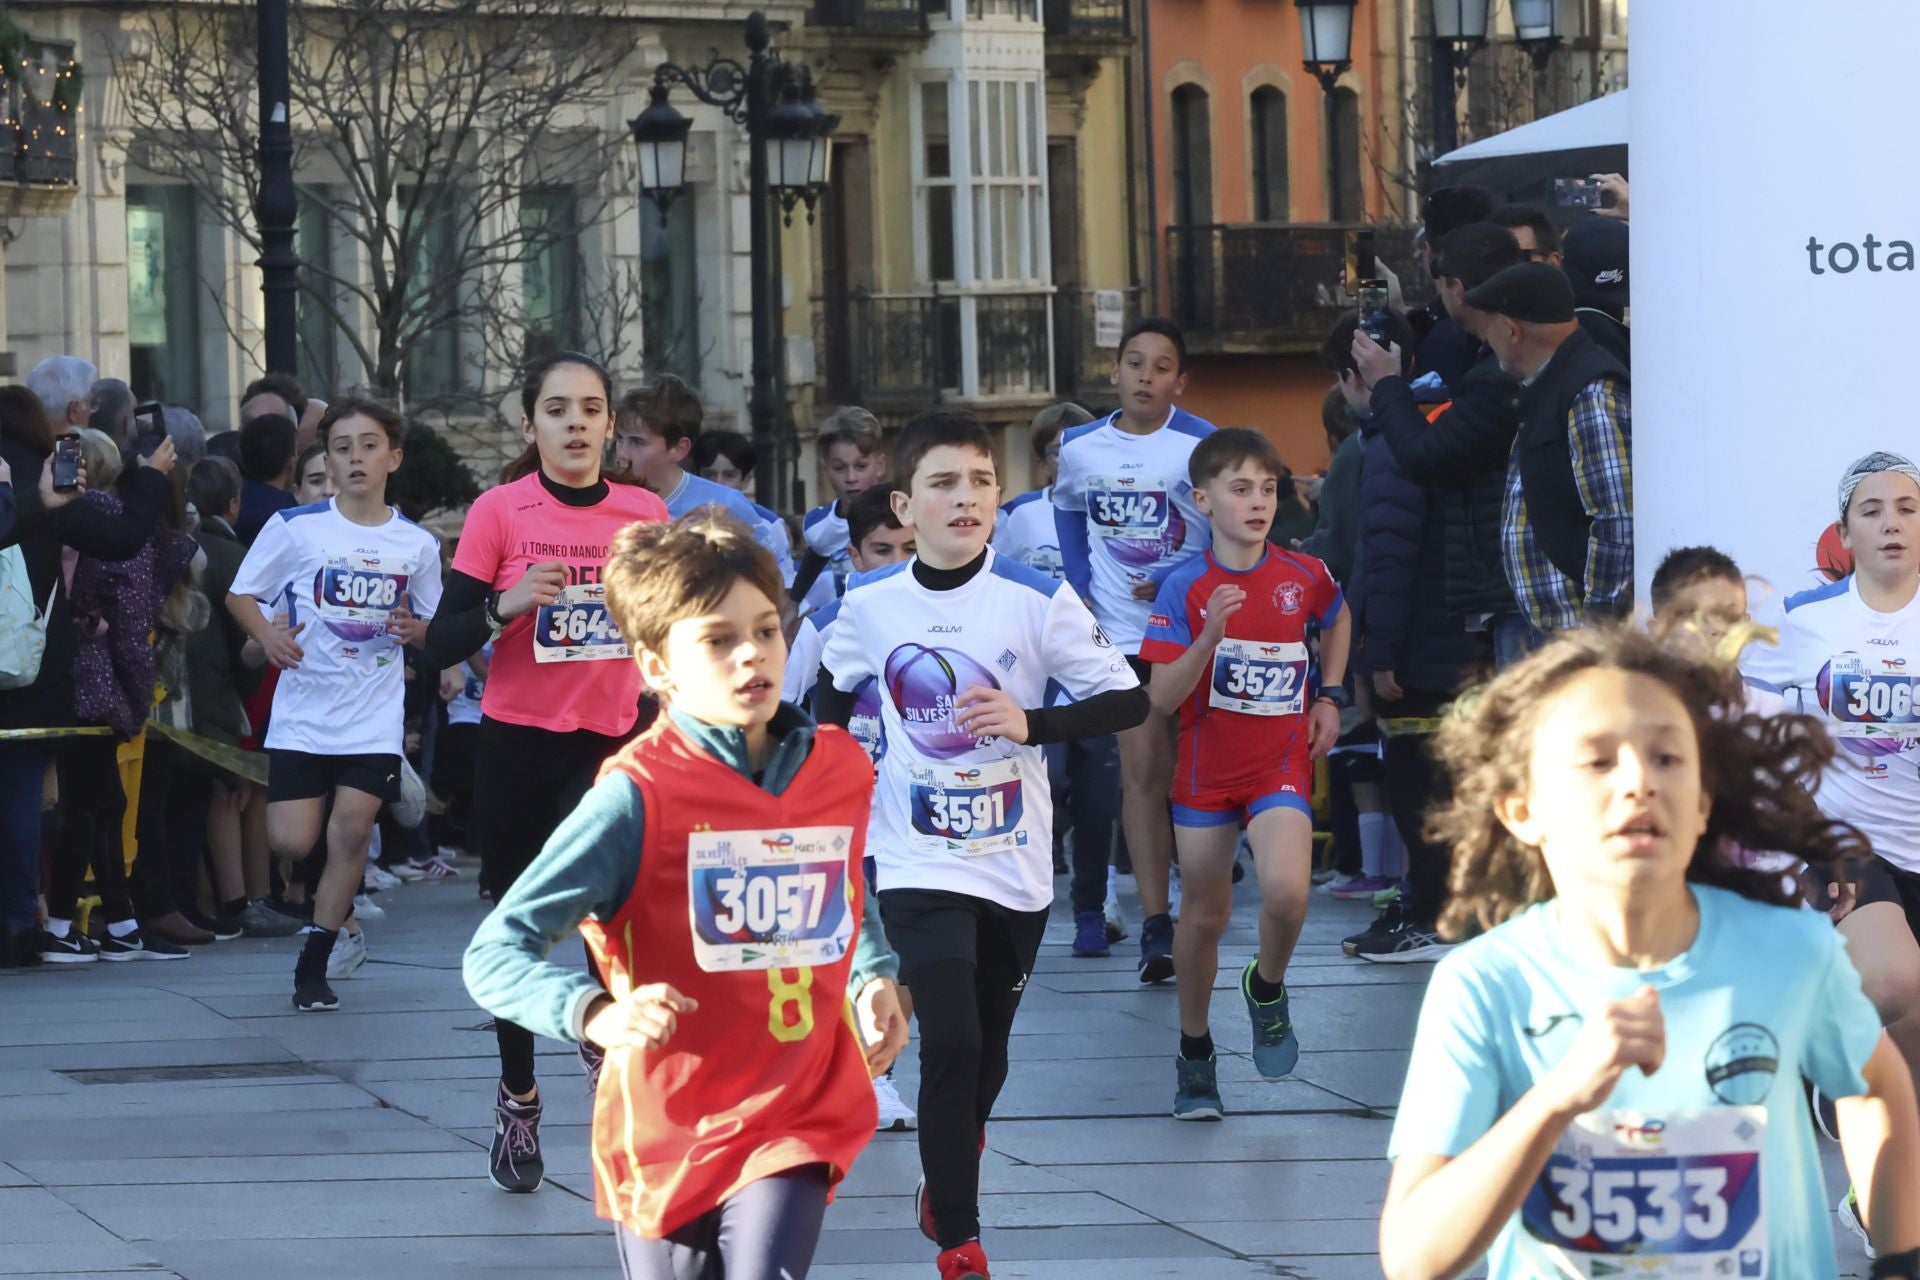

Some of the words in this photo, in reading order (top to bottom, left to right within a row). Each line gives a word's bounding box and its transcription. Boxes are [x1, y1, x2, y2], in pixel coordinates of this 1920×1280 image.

[1096, 496, 1158, 522] 3342
[522, 541, 528, 555] V
[530, 541, 567, 558] TORNEO
[570, 545, 609, 559] MANOLO
[335, 575, 398, 606] 3028
[1227, 663, 1296, 697] 3522
[929, 791, 1005, 833] 3591
[714, 872, 827, 935] 3057
[767, 966, 815, 1043] 8
[1551, 1167, 1728, 1242] 3533
